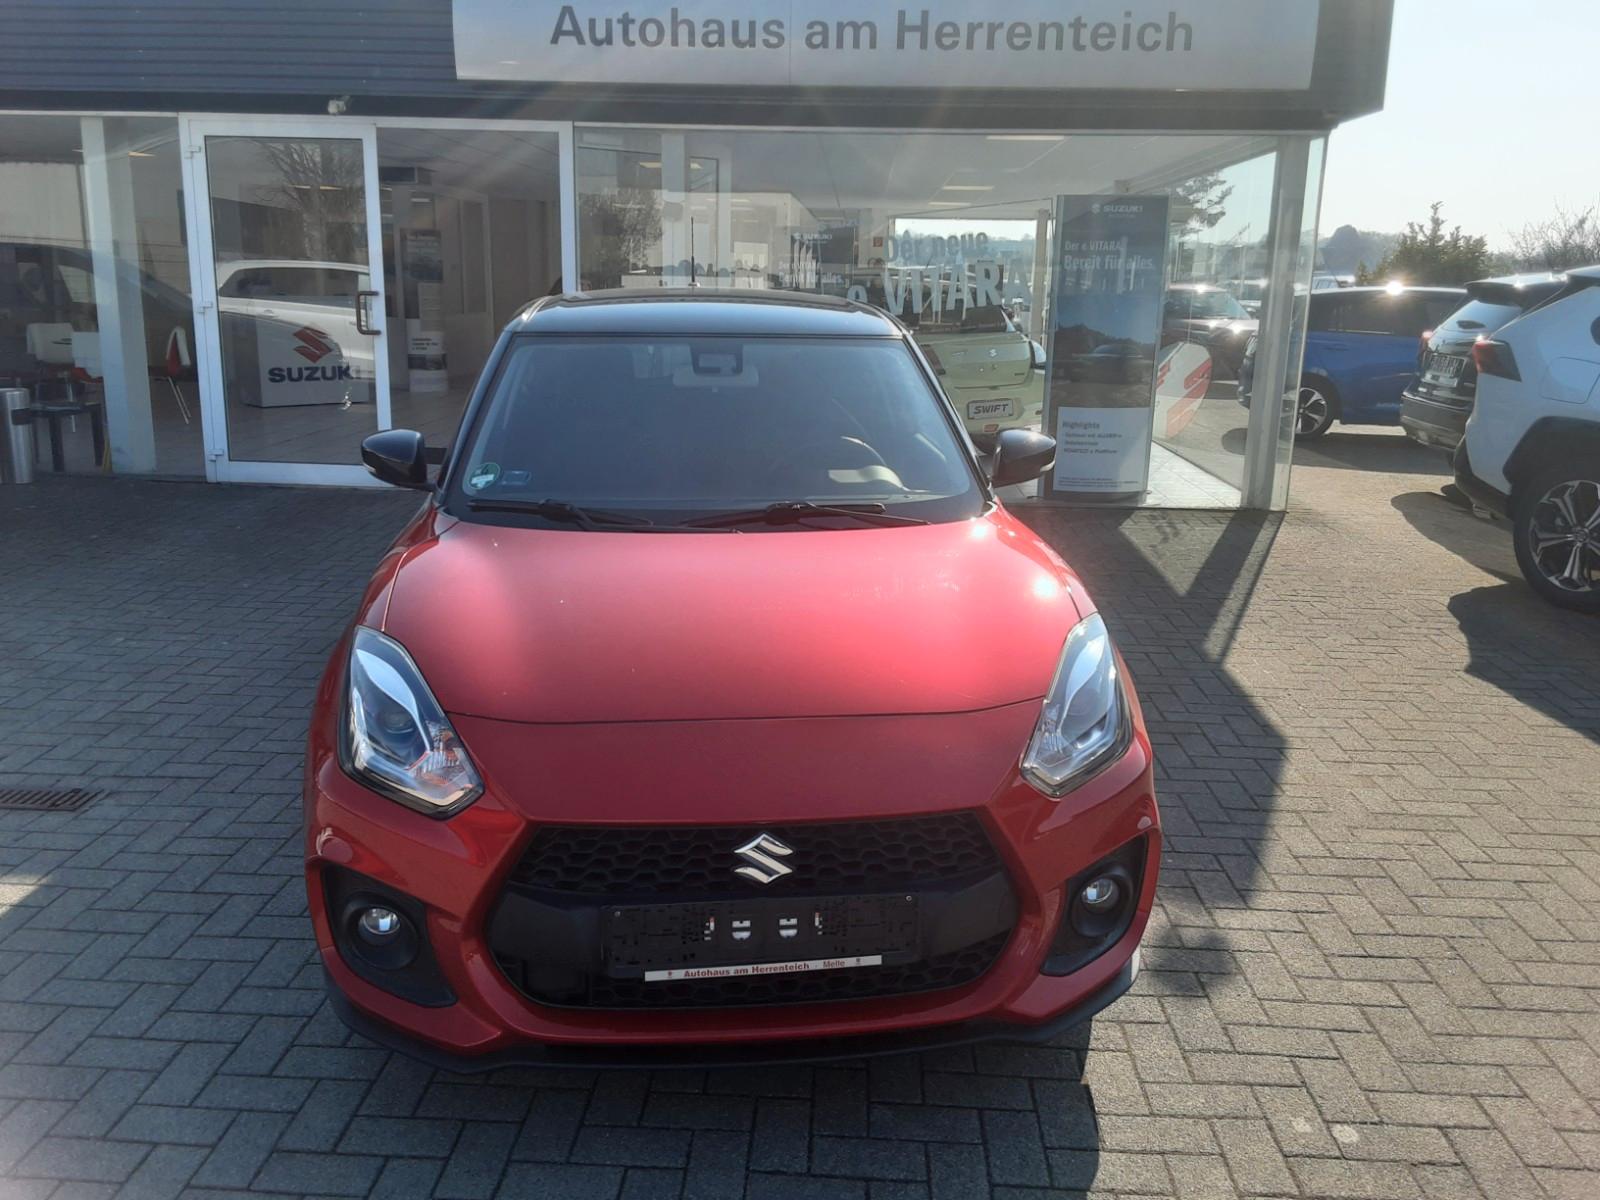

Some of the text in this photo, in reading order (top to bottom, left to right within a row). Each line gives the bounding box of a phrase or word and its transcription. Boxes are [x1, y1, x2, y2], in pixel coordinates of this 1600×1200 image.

[550, 5, 1193, 51] Autohaus am Herrenteich
[932, 231, 988, 256] neue
[880, 258, 1032, 316] VITARA
[973, 403, 1009, 415] SWIFT
[684, 969, 730, 978] Autohaus
[752, 962, 810, 974] Herrenteich
[823, 959, 845, 969] Melle
